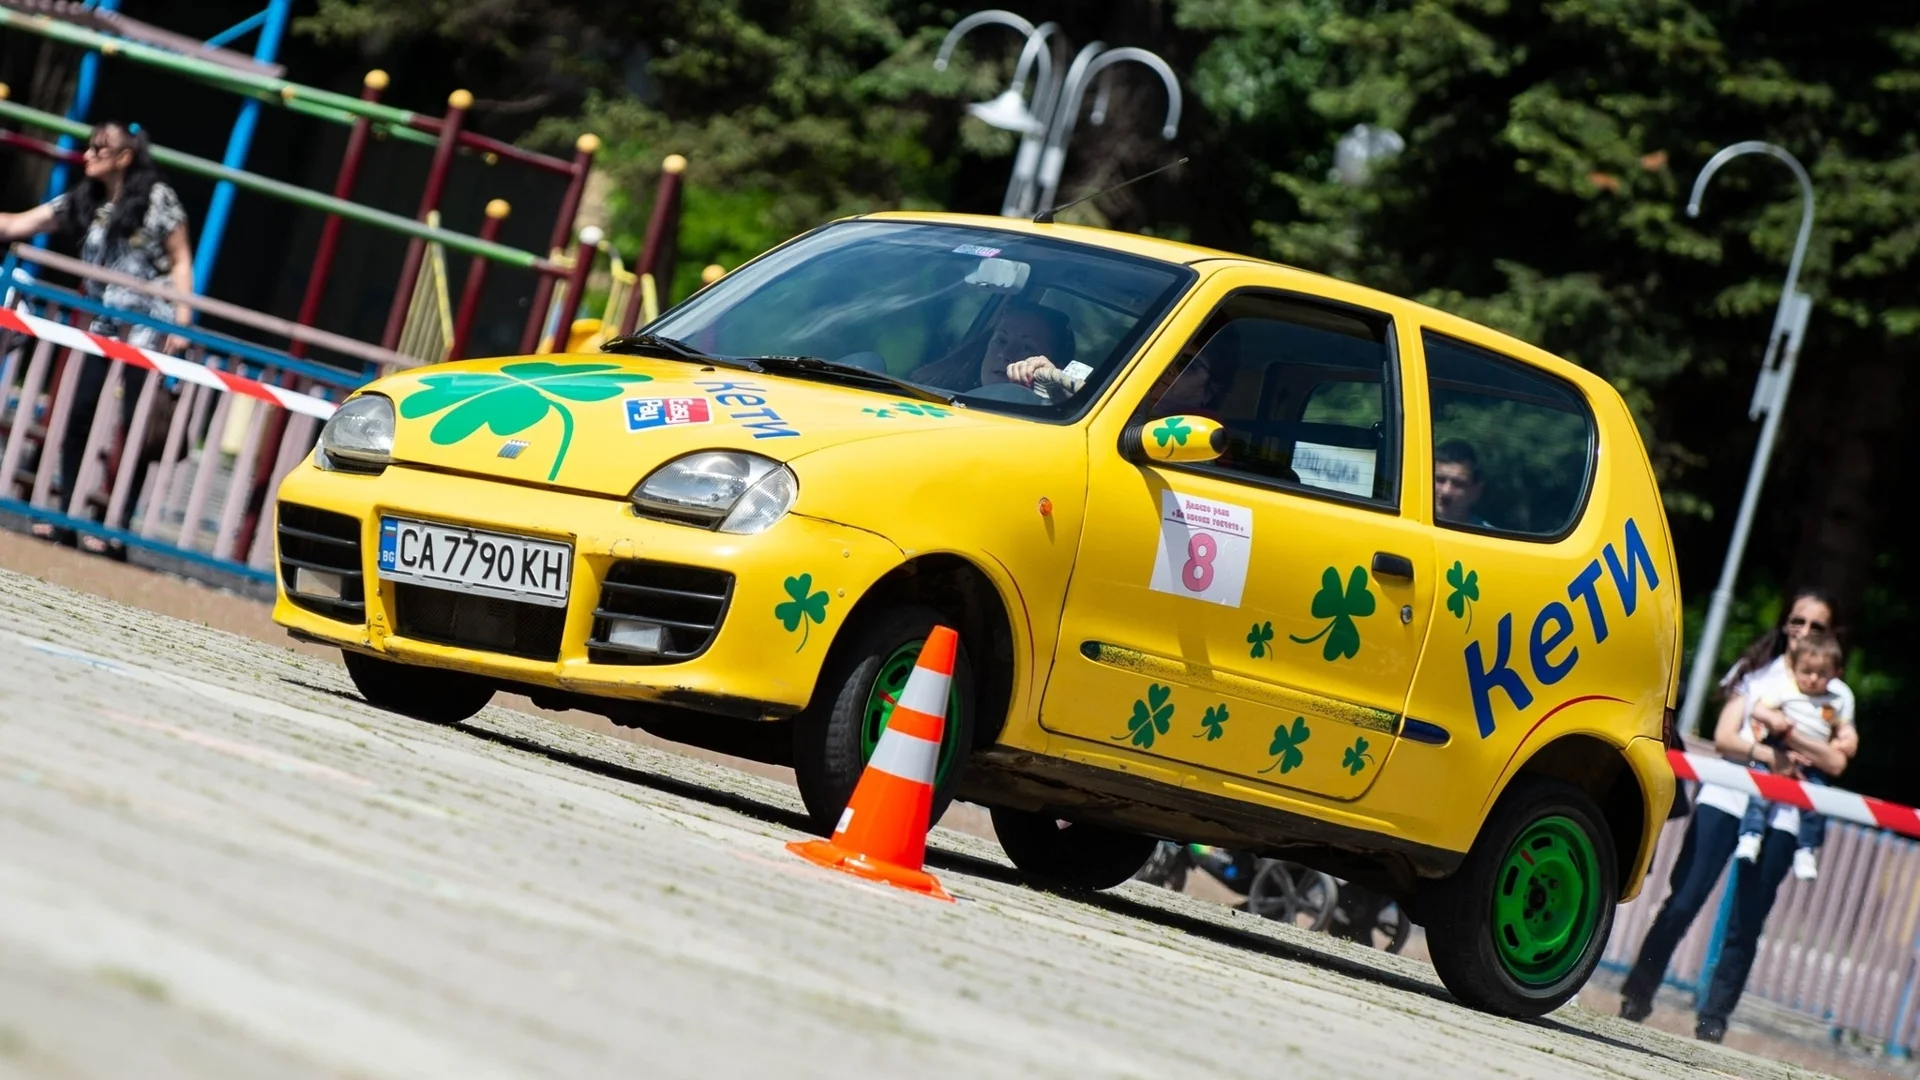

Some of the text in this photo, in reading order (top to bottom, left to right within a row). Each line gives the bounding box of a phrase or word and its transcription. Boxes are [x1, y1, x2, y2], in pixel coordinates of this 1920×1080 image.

[633, 399, 663, 422] Pay
[665, 398, 693, 424] Easy
[693, 381, 801, 439] Кети
[383, 551, 395, 563] BG
[441, 535, 515, 582] 7790
[1182, 532, 1217, 593] 8
[1464, 517, 1660, 740] Кети
